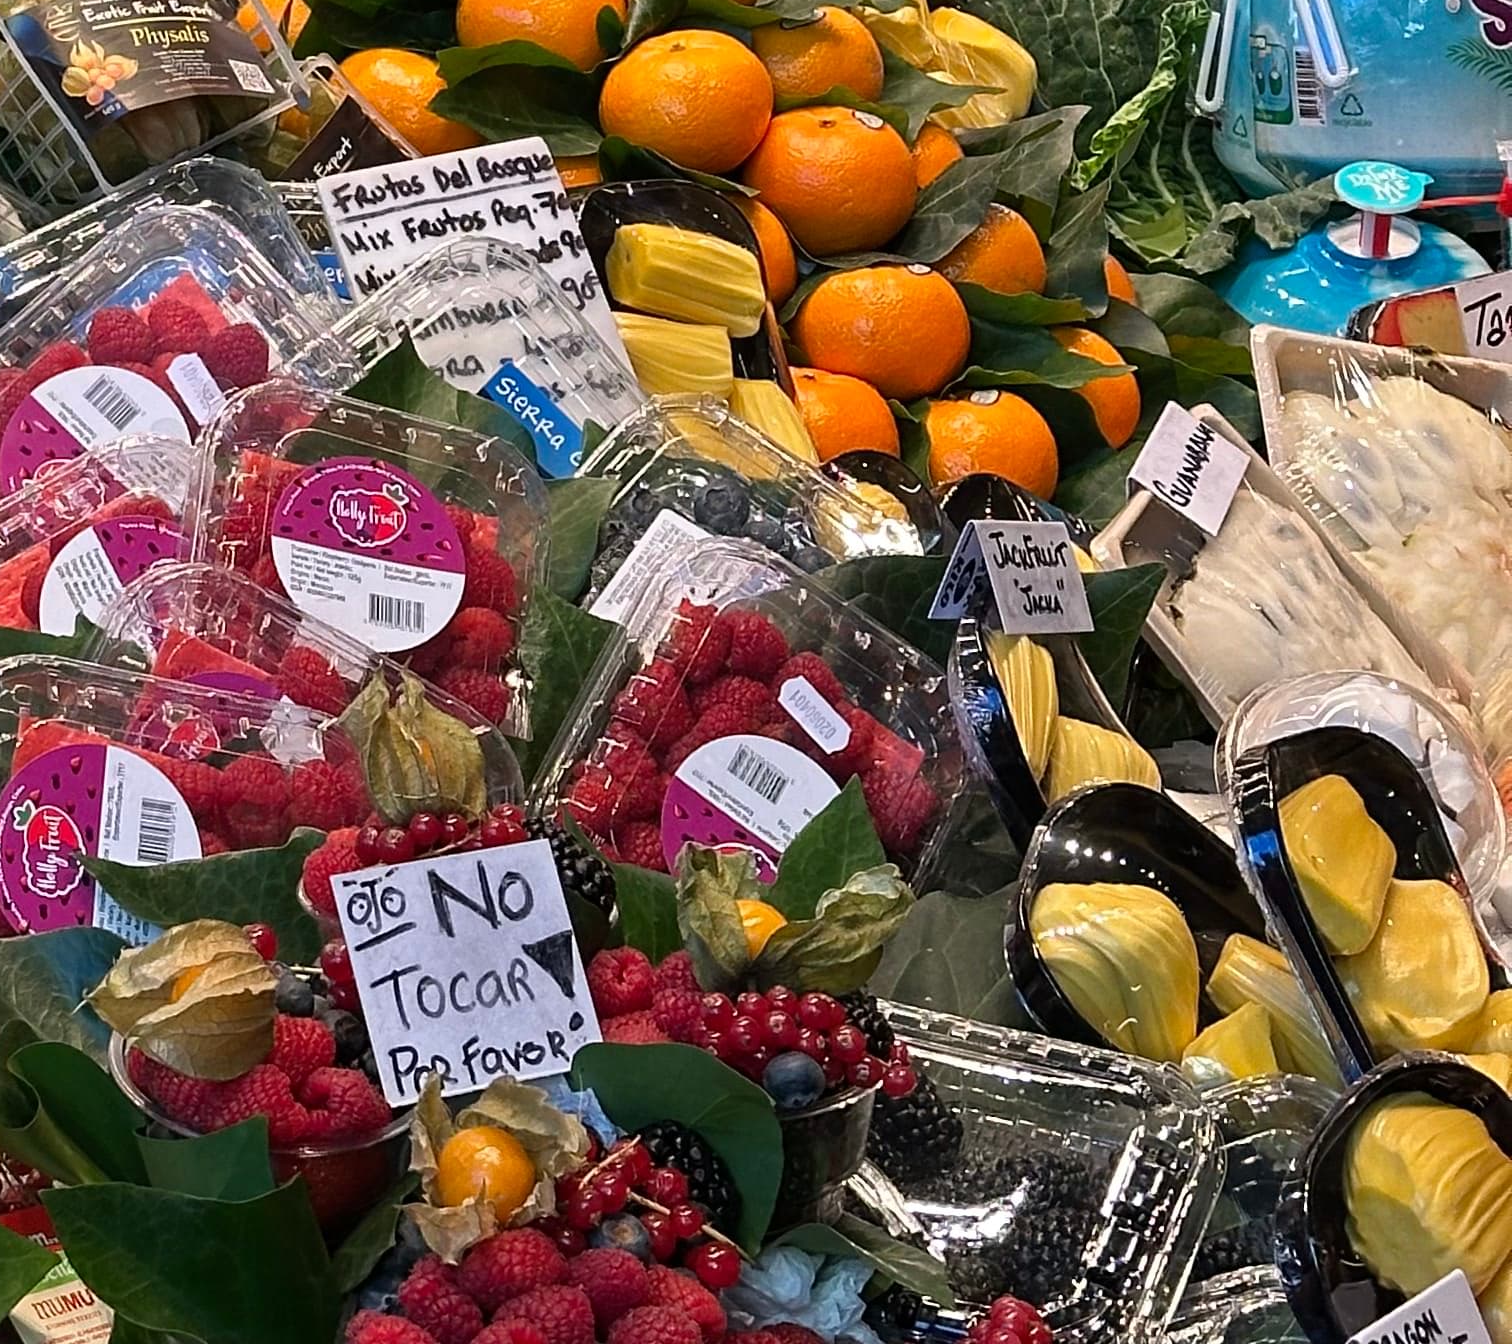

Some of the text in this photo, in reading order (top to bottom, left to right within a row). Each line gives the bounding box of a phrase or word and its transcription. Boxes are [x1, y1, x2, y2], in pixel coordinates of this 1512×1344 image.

[81, 3, 131, 23] Exotic
[133, 0, 167, 16] Fruit
[129, 24, 210, 49] Physalis
[433, 158, 473, 193] Del
[340, 222, 394, 256] Mix
[38, 810, 65, 852] Fruit
